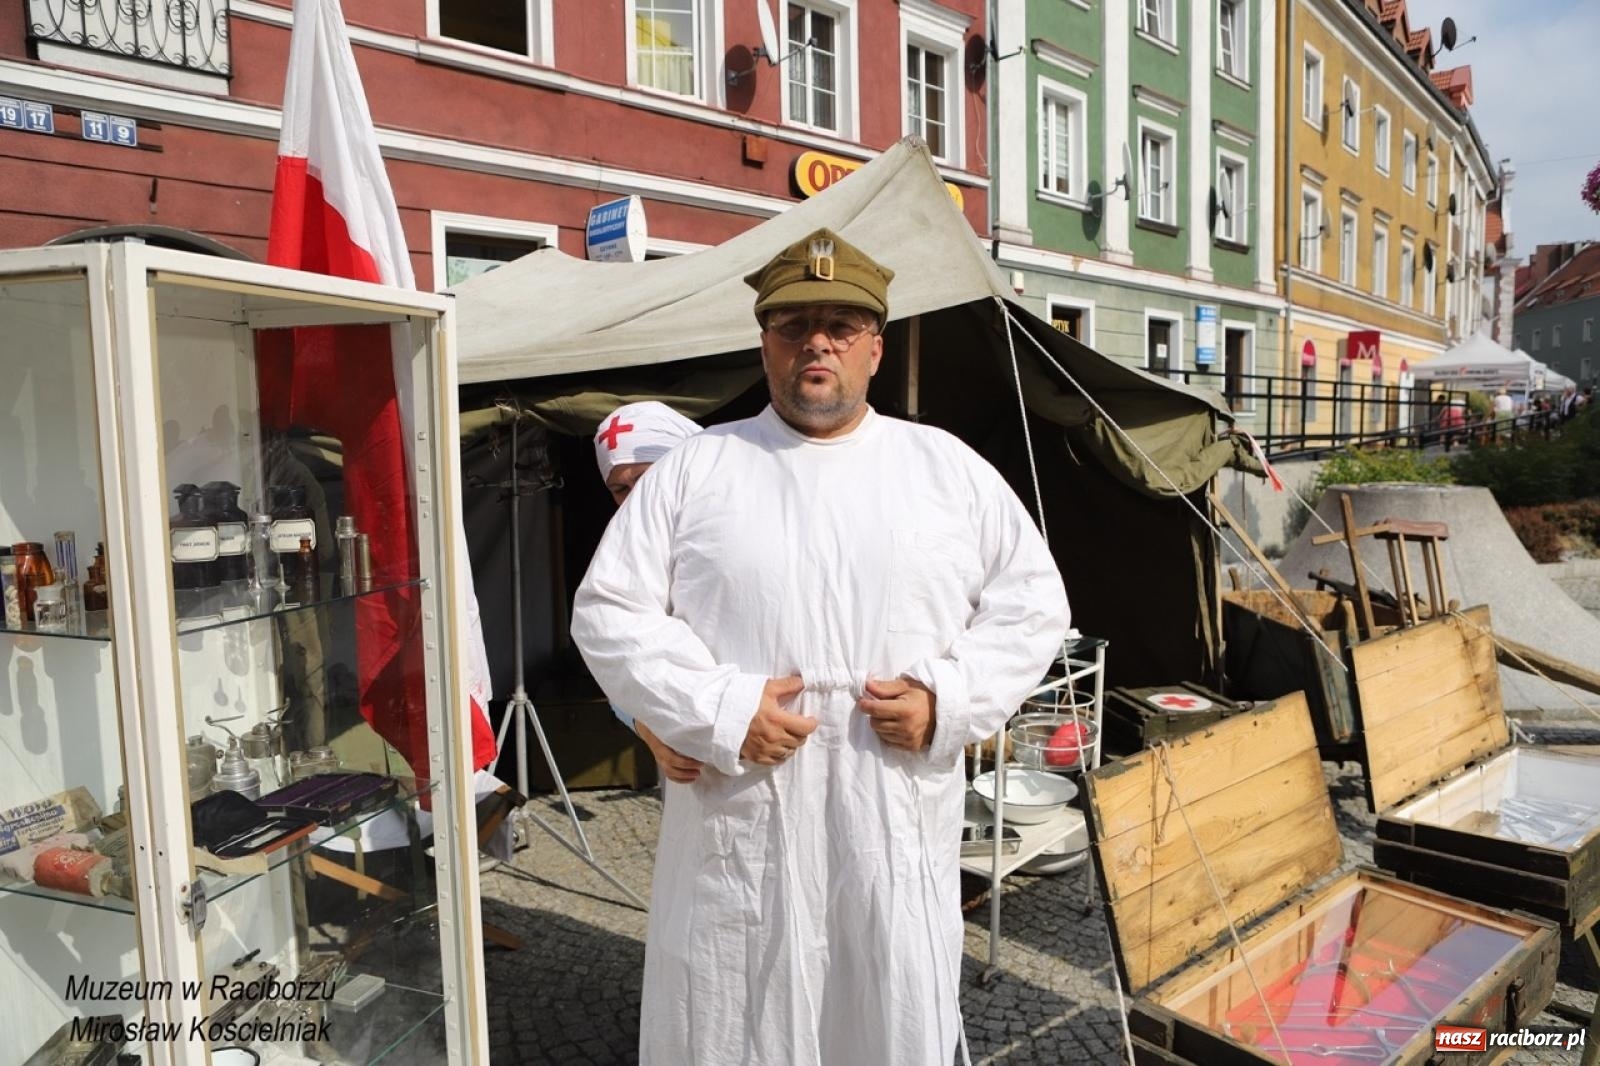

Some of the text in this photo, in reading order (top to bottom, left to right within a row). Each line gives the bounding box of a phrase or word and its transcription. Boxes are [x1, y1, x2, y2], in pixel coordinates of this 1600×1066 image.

[0, 106, 16, 121] 19
[30, 111, 46, 126] 17
[90, 121, 103, 135] 11
[118, 126, 130, 139] 9
[808, 159, 856, 191] OP
[1357, 341, 1376, 359] M
